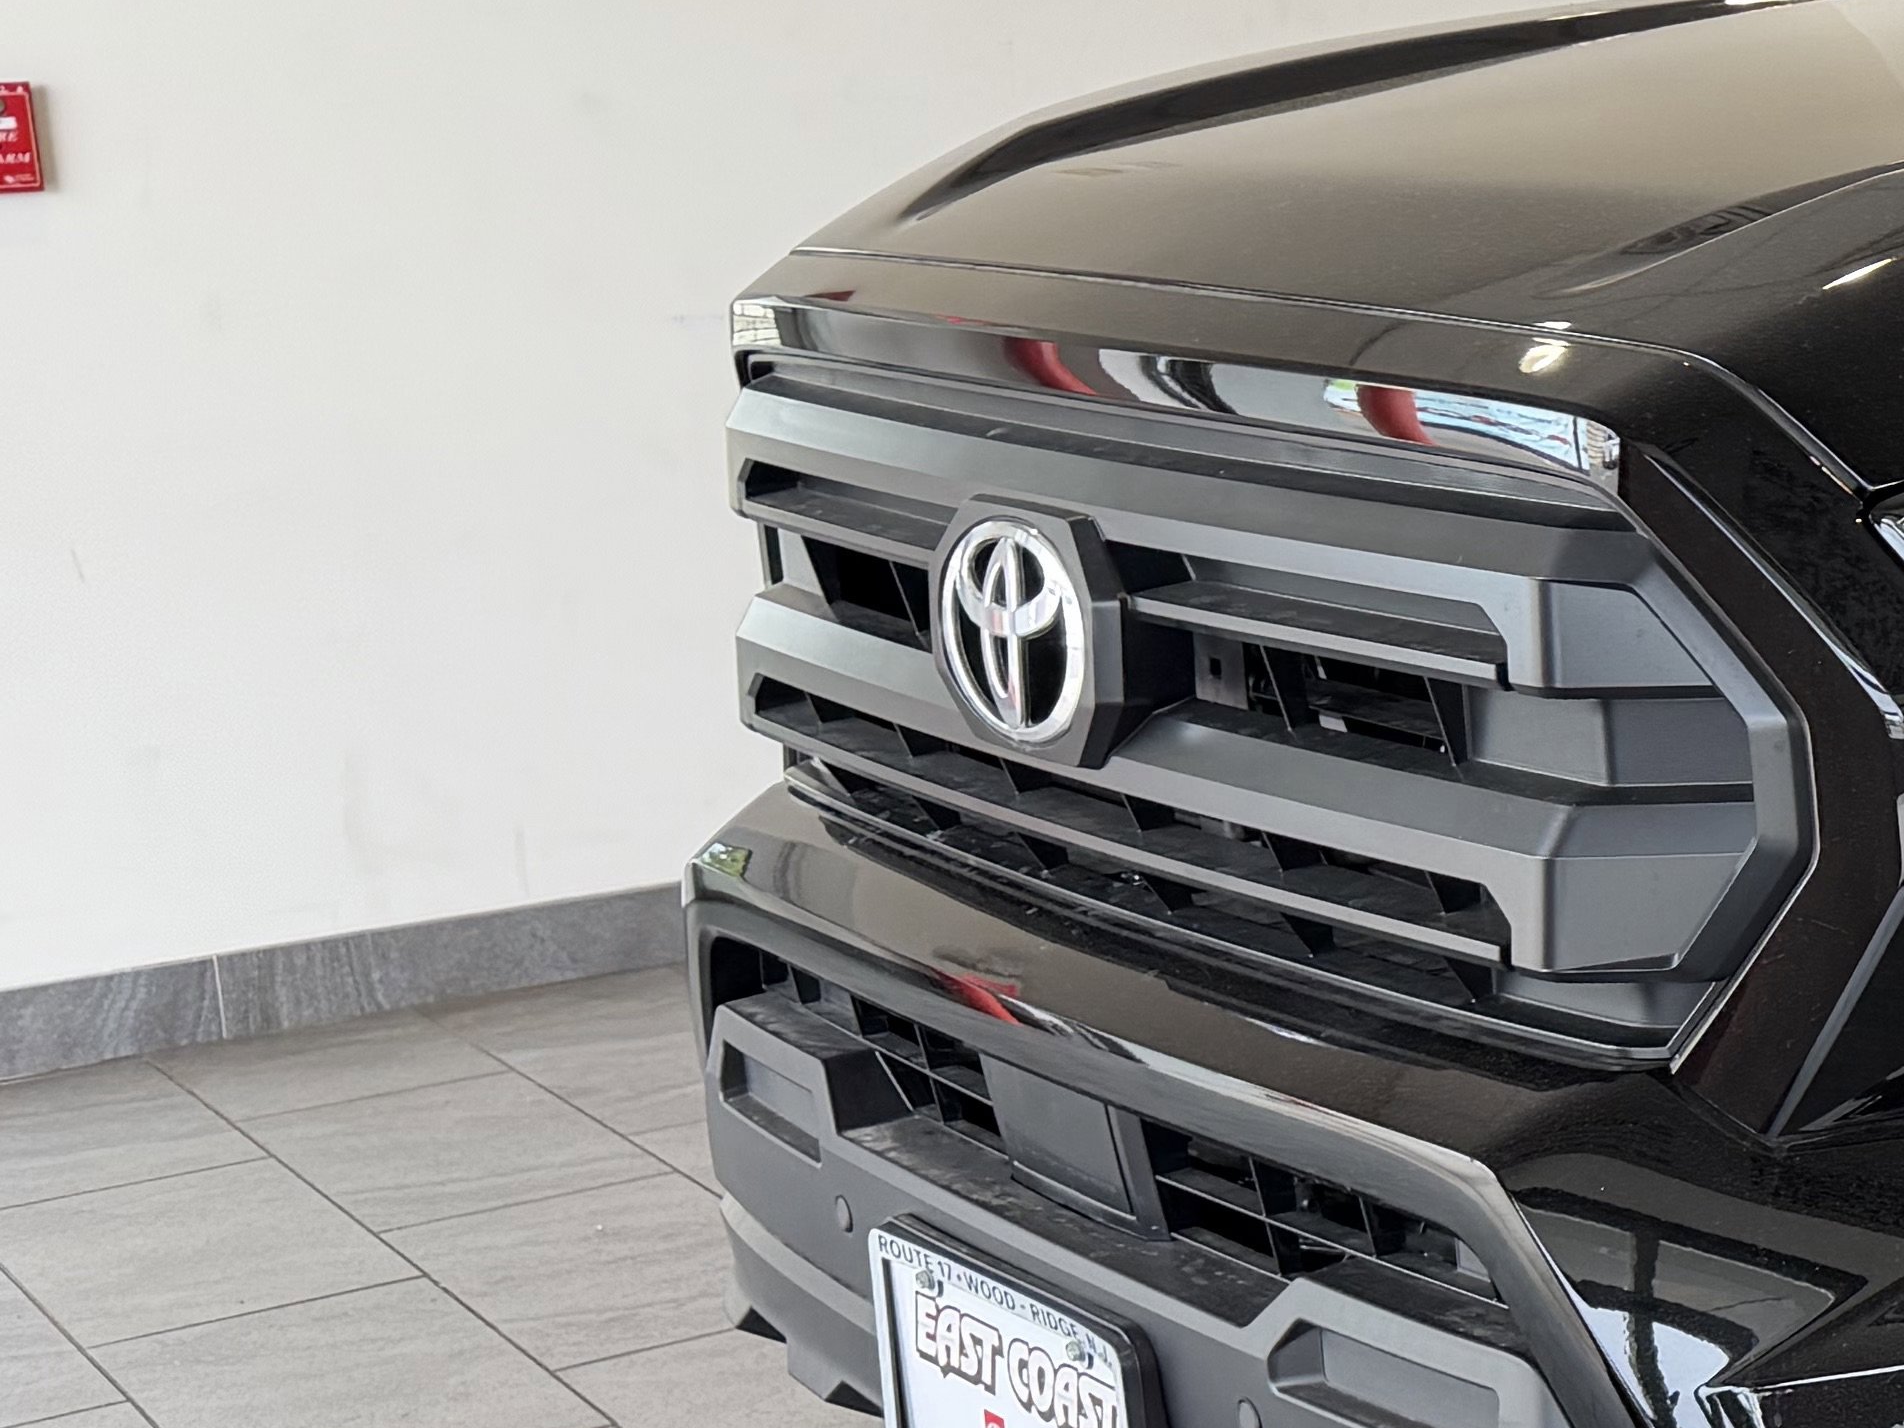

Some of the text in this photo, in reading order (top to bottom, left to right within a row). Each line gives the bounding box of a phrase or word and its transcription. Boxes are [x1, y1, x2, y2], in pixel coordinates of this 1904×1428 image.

[878, 1234, 934, 1272] ROUTE
[937, 1260, 952, 1282] 17
[963, 1272, 1016, 1311] WOOD
[1029, 1303, 1079, 1339] RIDGE
[915, 1291, 1004, 1397] EAST
